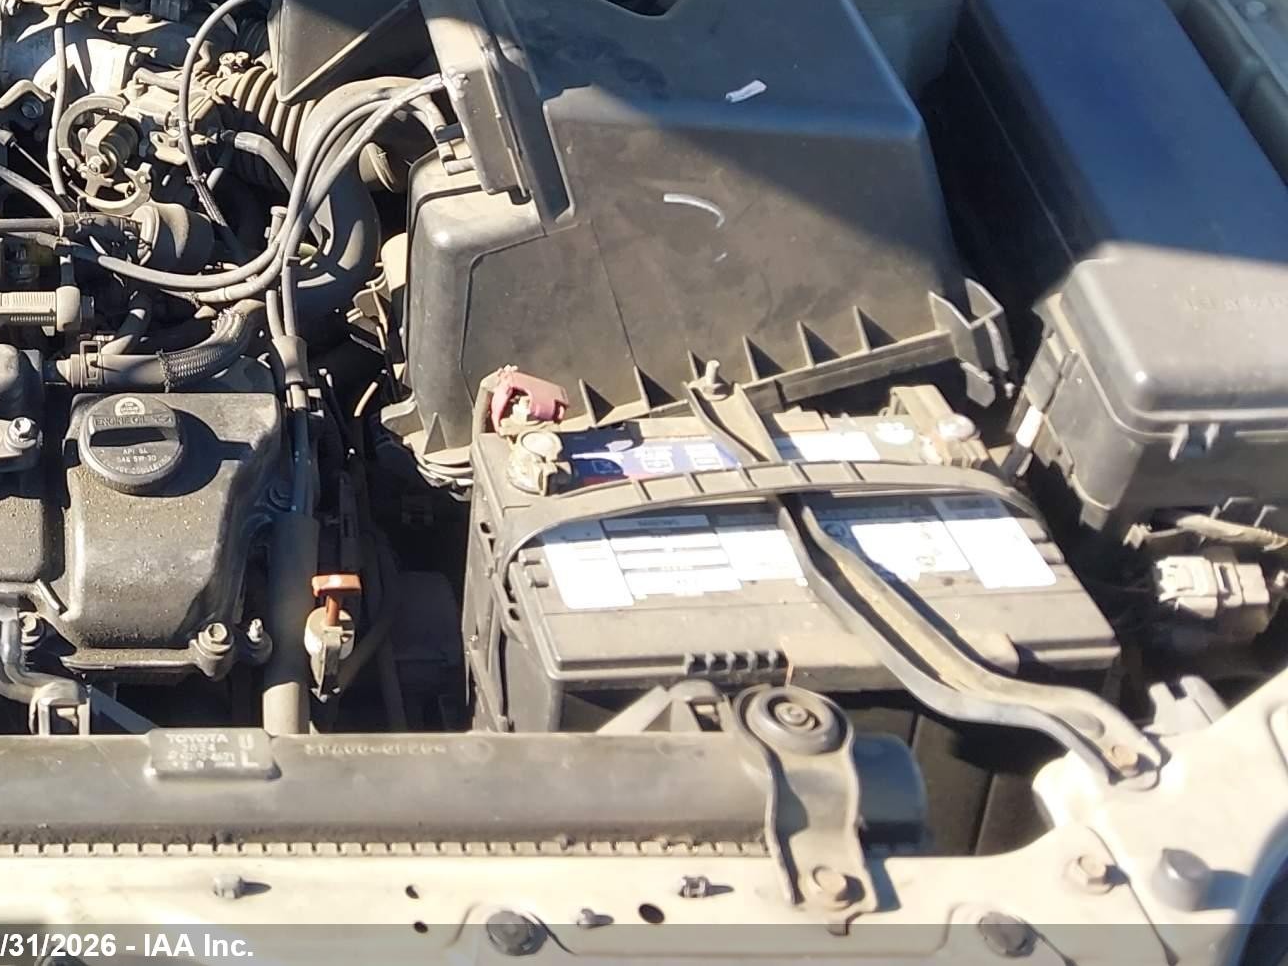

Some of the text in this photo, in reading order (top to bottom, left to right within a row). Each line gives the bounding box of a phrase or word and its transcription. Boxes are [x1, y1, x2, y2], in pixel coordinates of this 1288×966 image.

[95, 415, 145, 426] ENGINE OIL
[165, 733, 229, 743] TOYOTA
